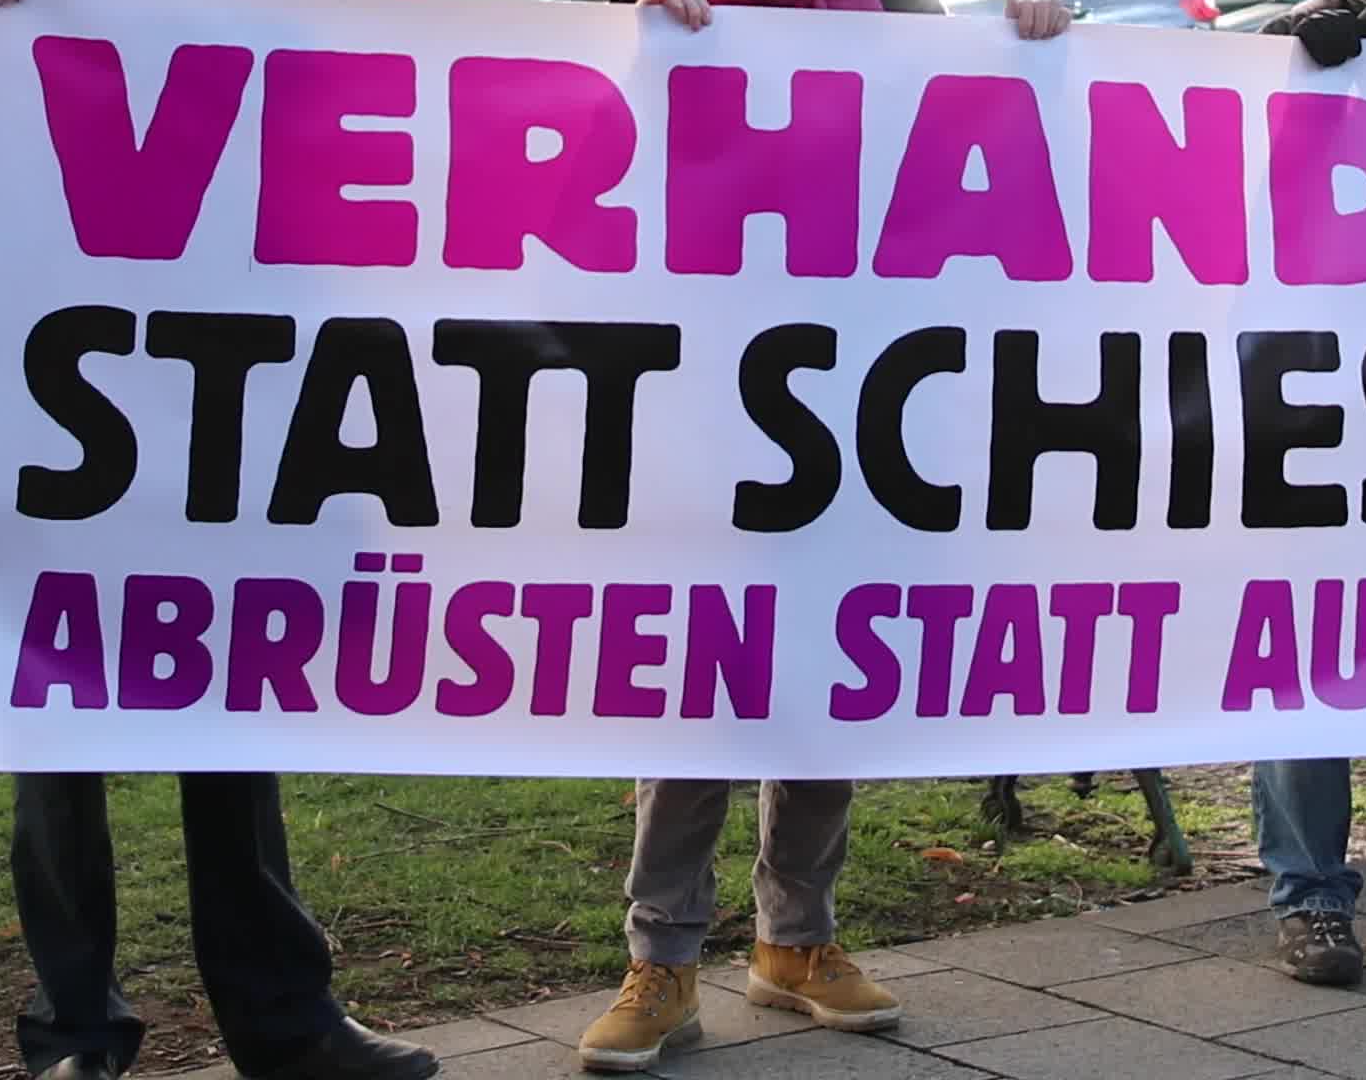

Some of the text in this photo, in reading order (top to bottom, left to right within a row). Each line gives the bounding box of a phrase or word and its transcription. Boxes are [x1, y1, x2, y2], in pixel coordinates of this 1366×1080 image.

[14, 303, 683, 530] STATT
[9, 550, 779, 720] ABRÜSTEN
[827, 581, 1182, 722] STATT
